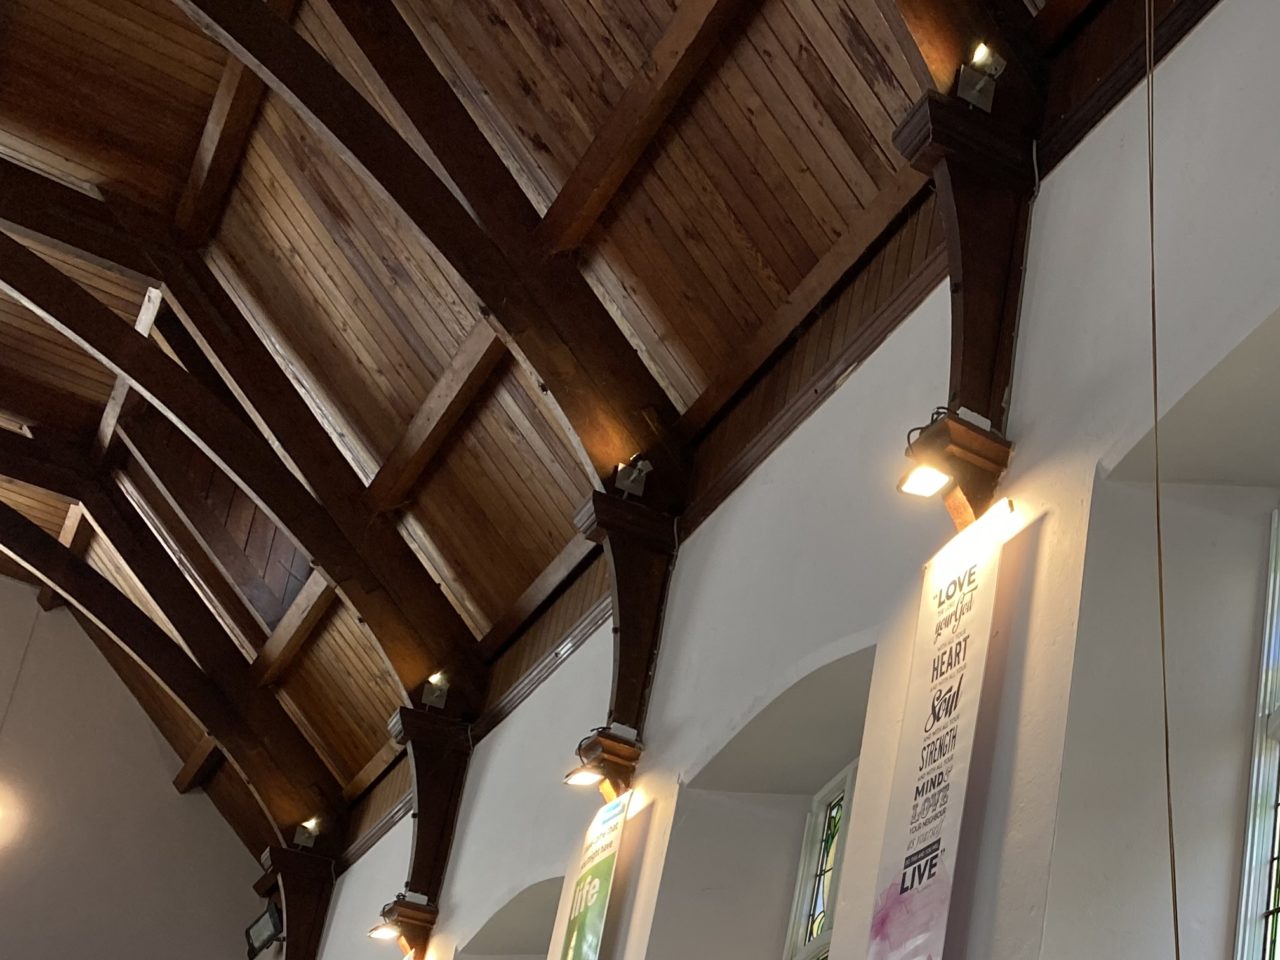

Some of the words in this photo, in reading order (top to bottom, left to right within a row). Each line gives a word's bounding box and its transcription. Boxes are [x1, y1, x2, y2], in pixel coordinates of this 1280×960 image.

[952, 584, 978, 634] God
[931, 634, 969, 683] HEART
[924, 673, 963, 733] Soul
[919, 724, 958, 771] STRENGTH
[910, 783, 949, 826] LOVE
[914, 771, 944, 801] MIND
[570, 874, 600, 921] life
